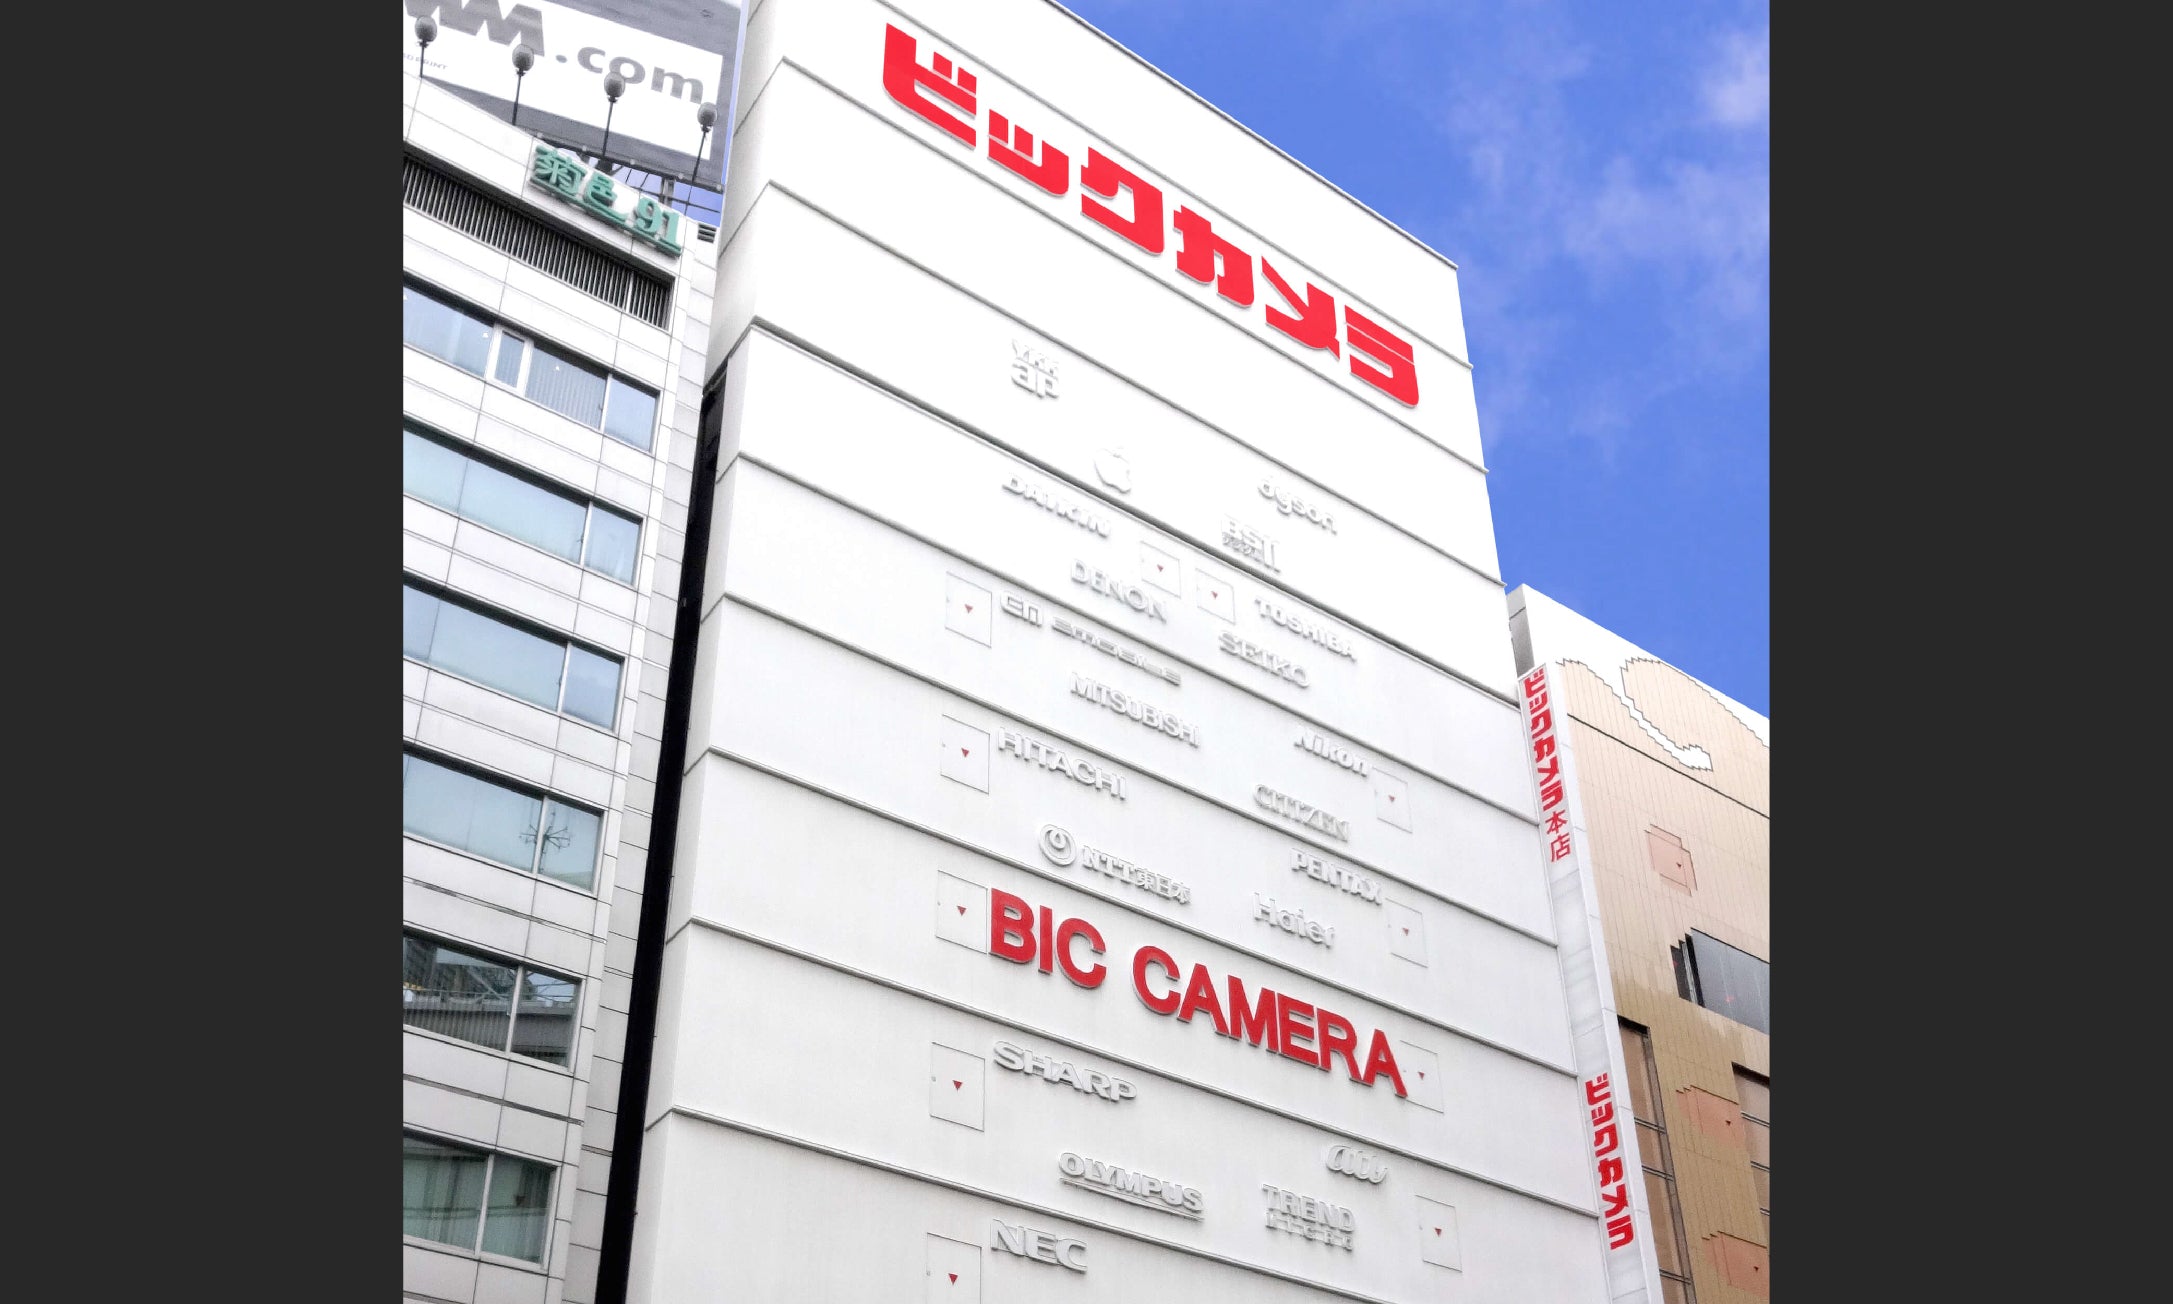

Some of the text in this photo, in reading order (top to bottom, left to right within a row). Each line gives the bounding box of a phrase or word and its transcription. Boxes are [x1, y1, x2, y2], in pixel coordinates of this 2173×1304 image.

[883, 23, 1419, 407] ビックカメラ
[1002, 472, 1111, 538] DAIKIN
[1257, 475, 1338, 535] dyson
[1070, 558, 1167, 623] DENON
[1218, 630, 1311, 688] SEIKO
[1254, 594, 1358, 662] TOSHIBA
[1070, 672, 1200, 748] MITSUBISHI
[997, 728, 1127, 800] HITACHI
[1294, 727, 1369, 776] Nikon
[1252, 784, 1351, 842] CITIZEN
[1289, 847, 1383, 905] PENTAX
[1252, 891, 1336, 949] Haier
[988, 887, 1409, 1098] BIC CAMERA
[993, 1040, 1138, 1103] SHARP
[1058, 1151, 1204, 1214] OLYMPUS
[1585, 1072, 1635, 1251] ビックカメラ
[1262, 1183, 1357, 1235] TREND
[990, 1219, 1089, 1275] NEC
